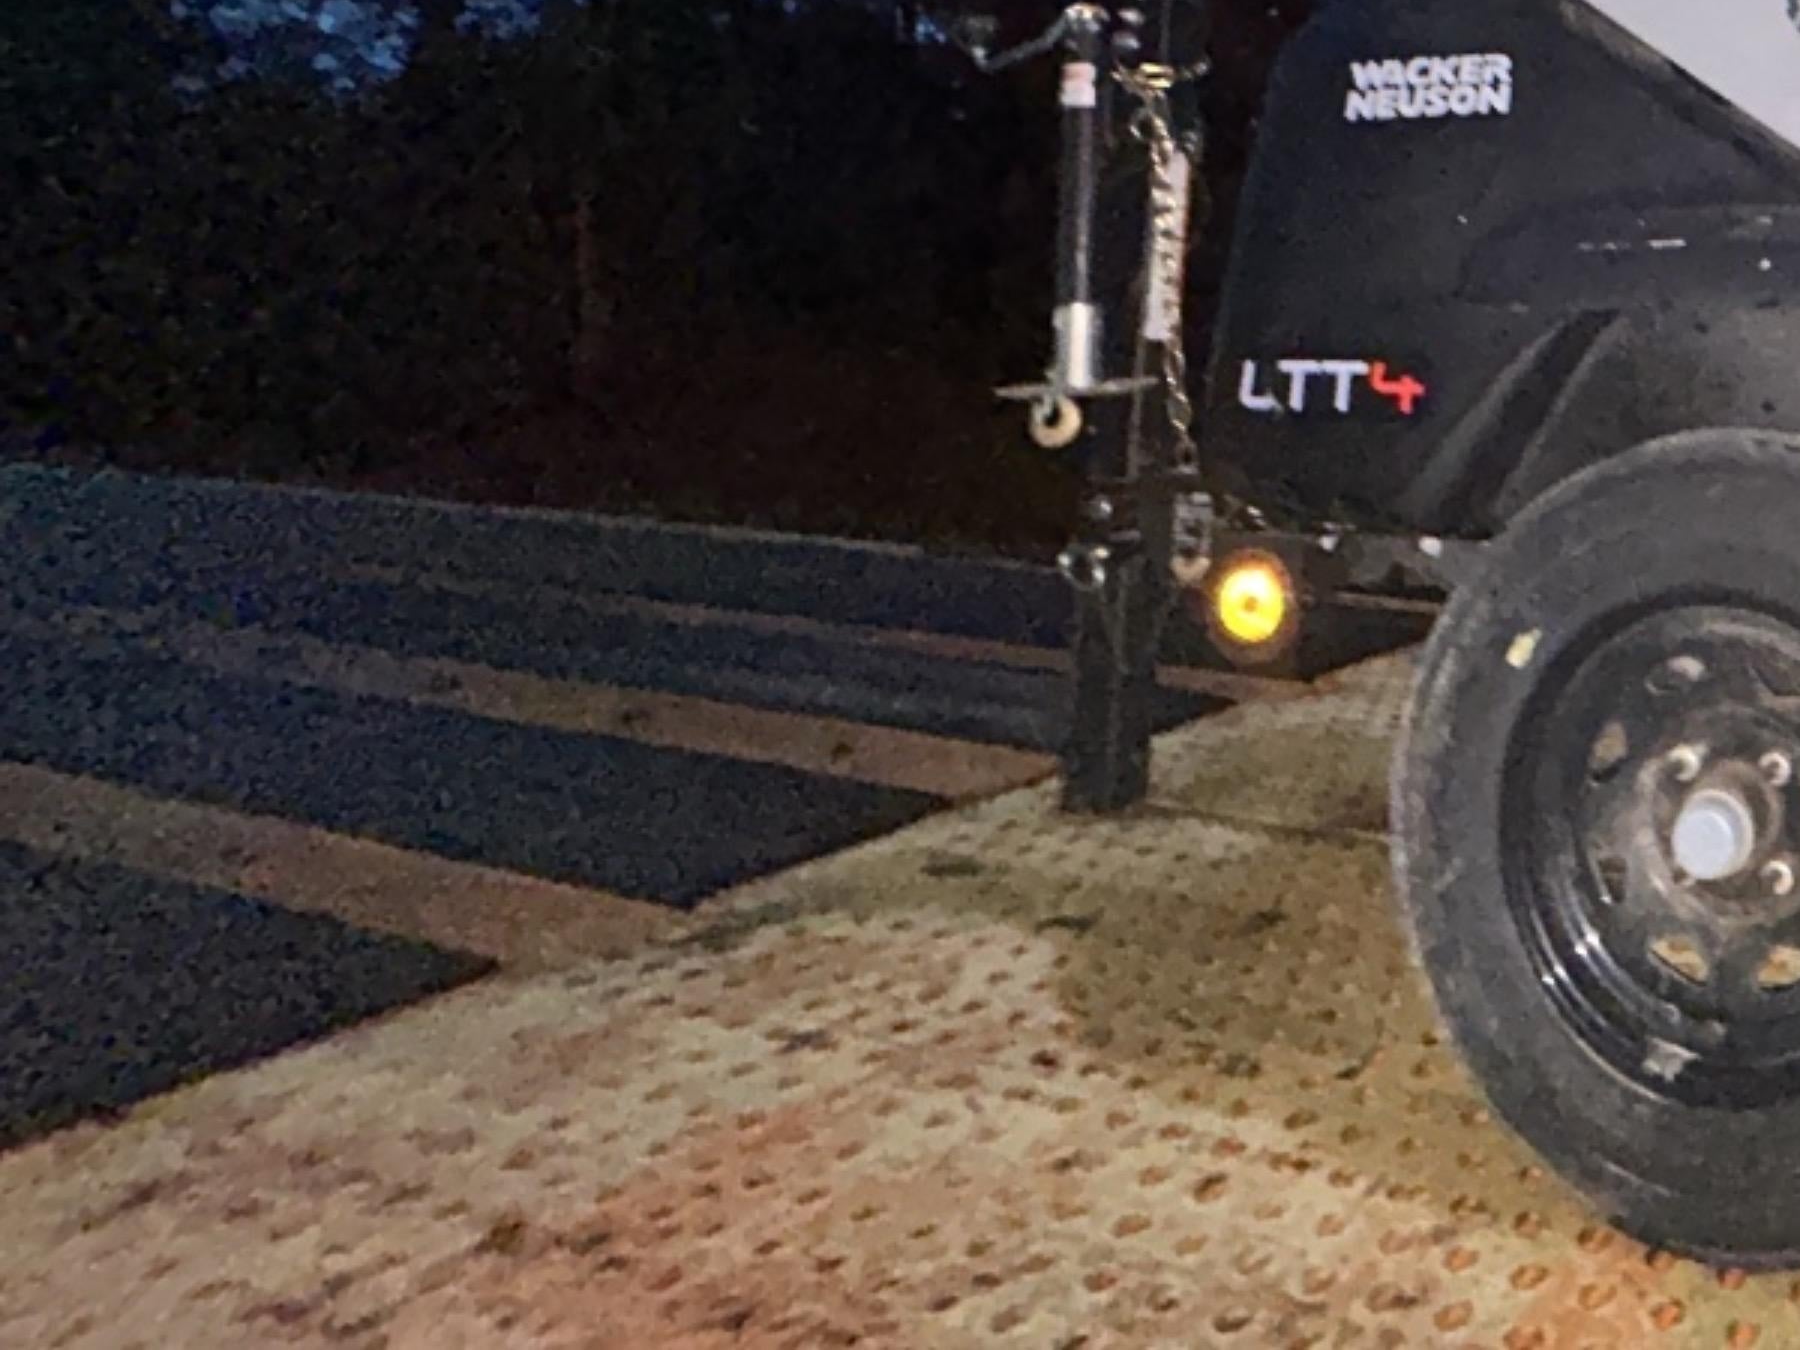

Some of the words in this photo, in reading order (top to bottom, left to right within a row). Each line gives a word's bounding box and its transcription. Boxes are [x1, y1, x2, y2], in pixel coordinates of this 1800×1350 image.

[1350, 52, 1512, 92] WACKER
[1344, 81, 1511, 123] NEUSON
[1238, 359, 1425, 415] LTT4
